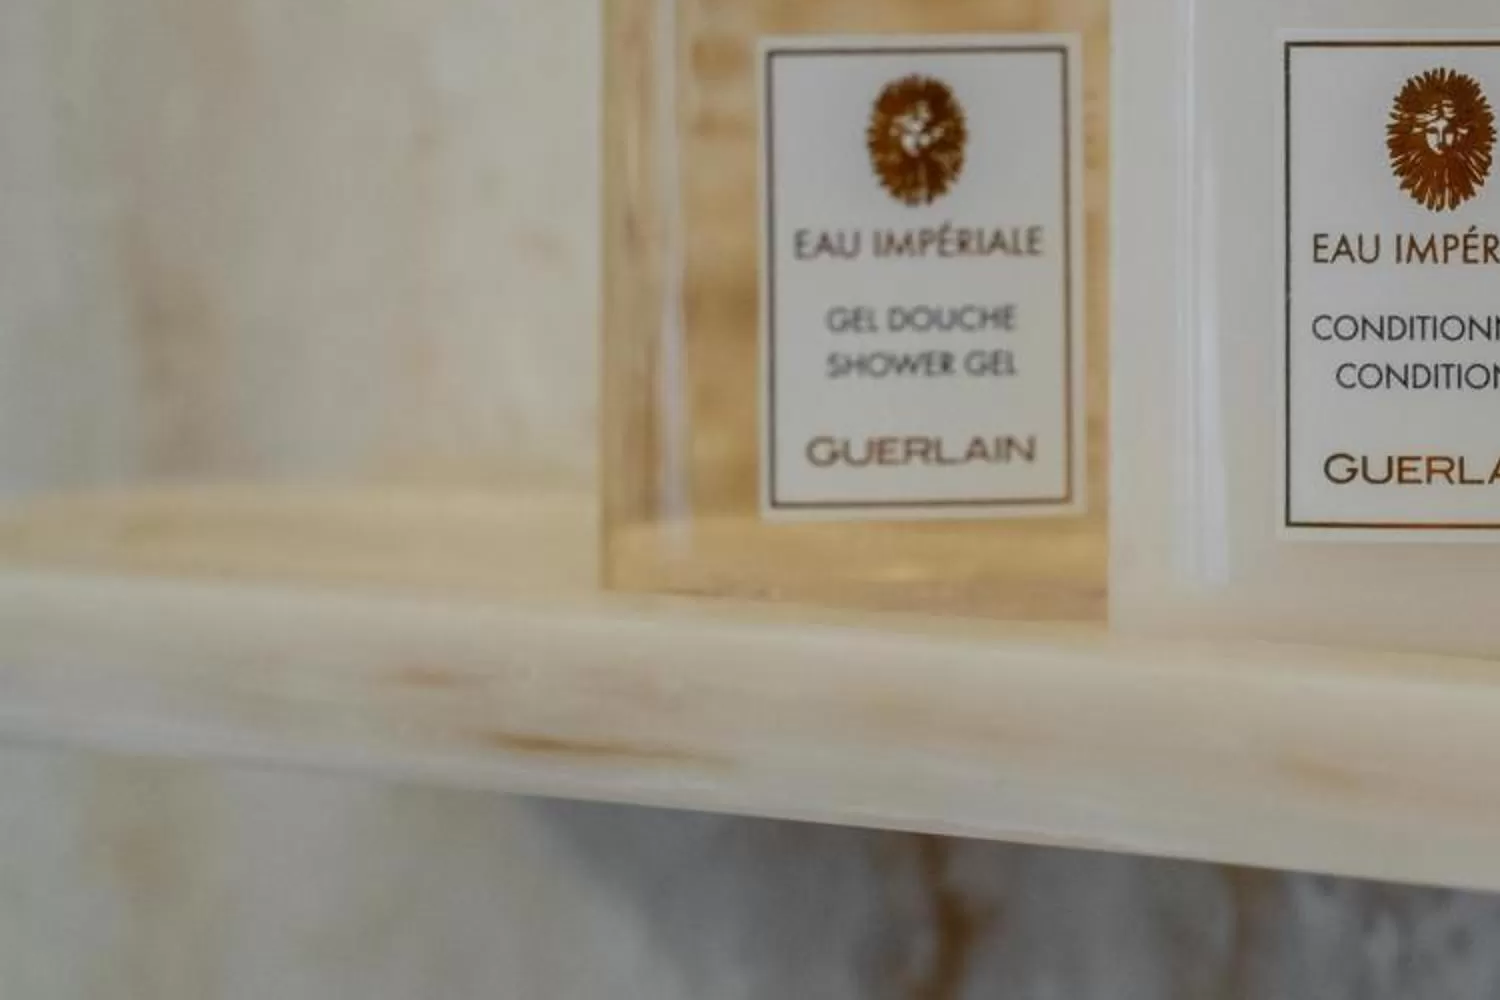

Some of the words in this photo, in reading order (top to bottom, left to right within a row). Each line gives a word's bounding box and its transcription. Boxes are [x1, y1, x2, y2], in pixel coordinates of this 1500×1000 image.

[795, 229, 860, 260] EAU
[873, 221, 1044, 258] IMPÉRIALE
[1312, 233, 1381, 264] EAU
[826, 306, 879, 333] GEL
[887, 304, 1016, 332] DOUCHE
[825, 351, 955, 378] SHOWER
[964, 350, 1017, 377] GEL
[806, 435, 1037, 467] GUERLAIN
